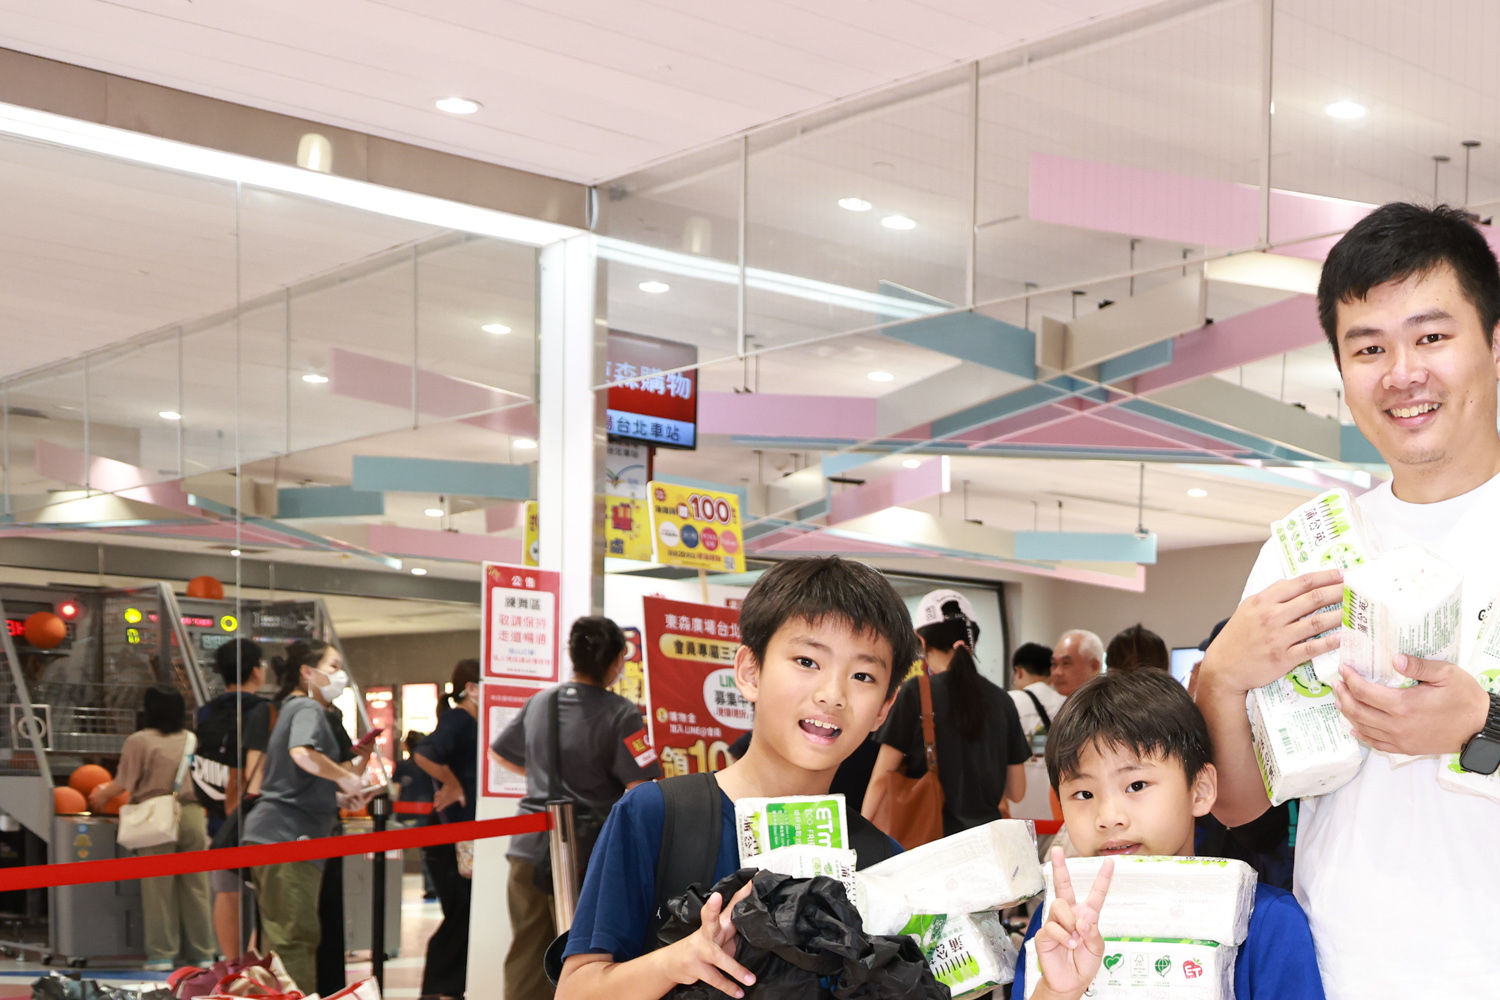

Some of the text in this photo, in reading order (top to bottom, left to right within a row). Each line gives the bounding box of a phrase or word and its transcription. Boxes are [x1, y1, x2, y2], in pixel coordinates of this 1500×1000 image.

[616, 416, 680, 442] 台北車站
[689, 494, 732, 525] 100
